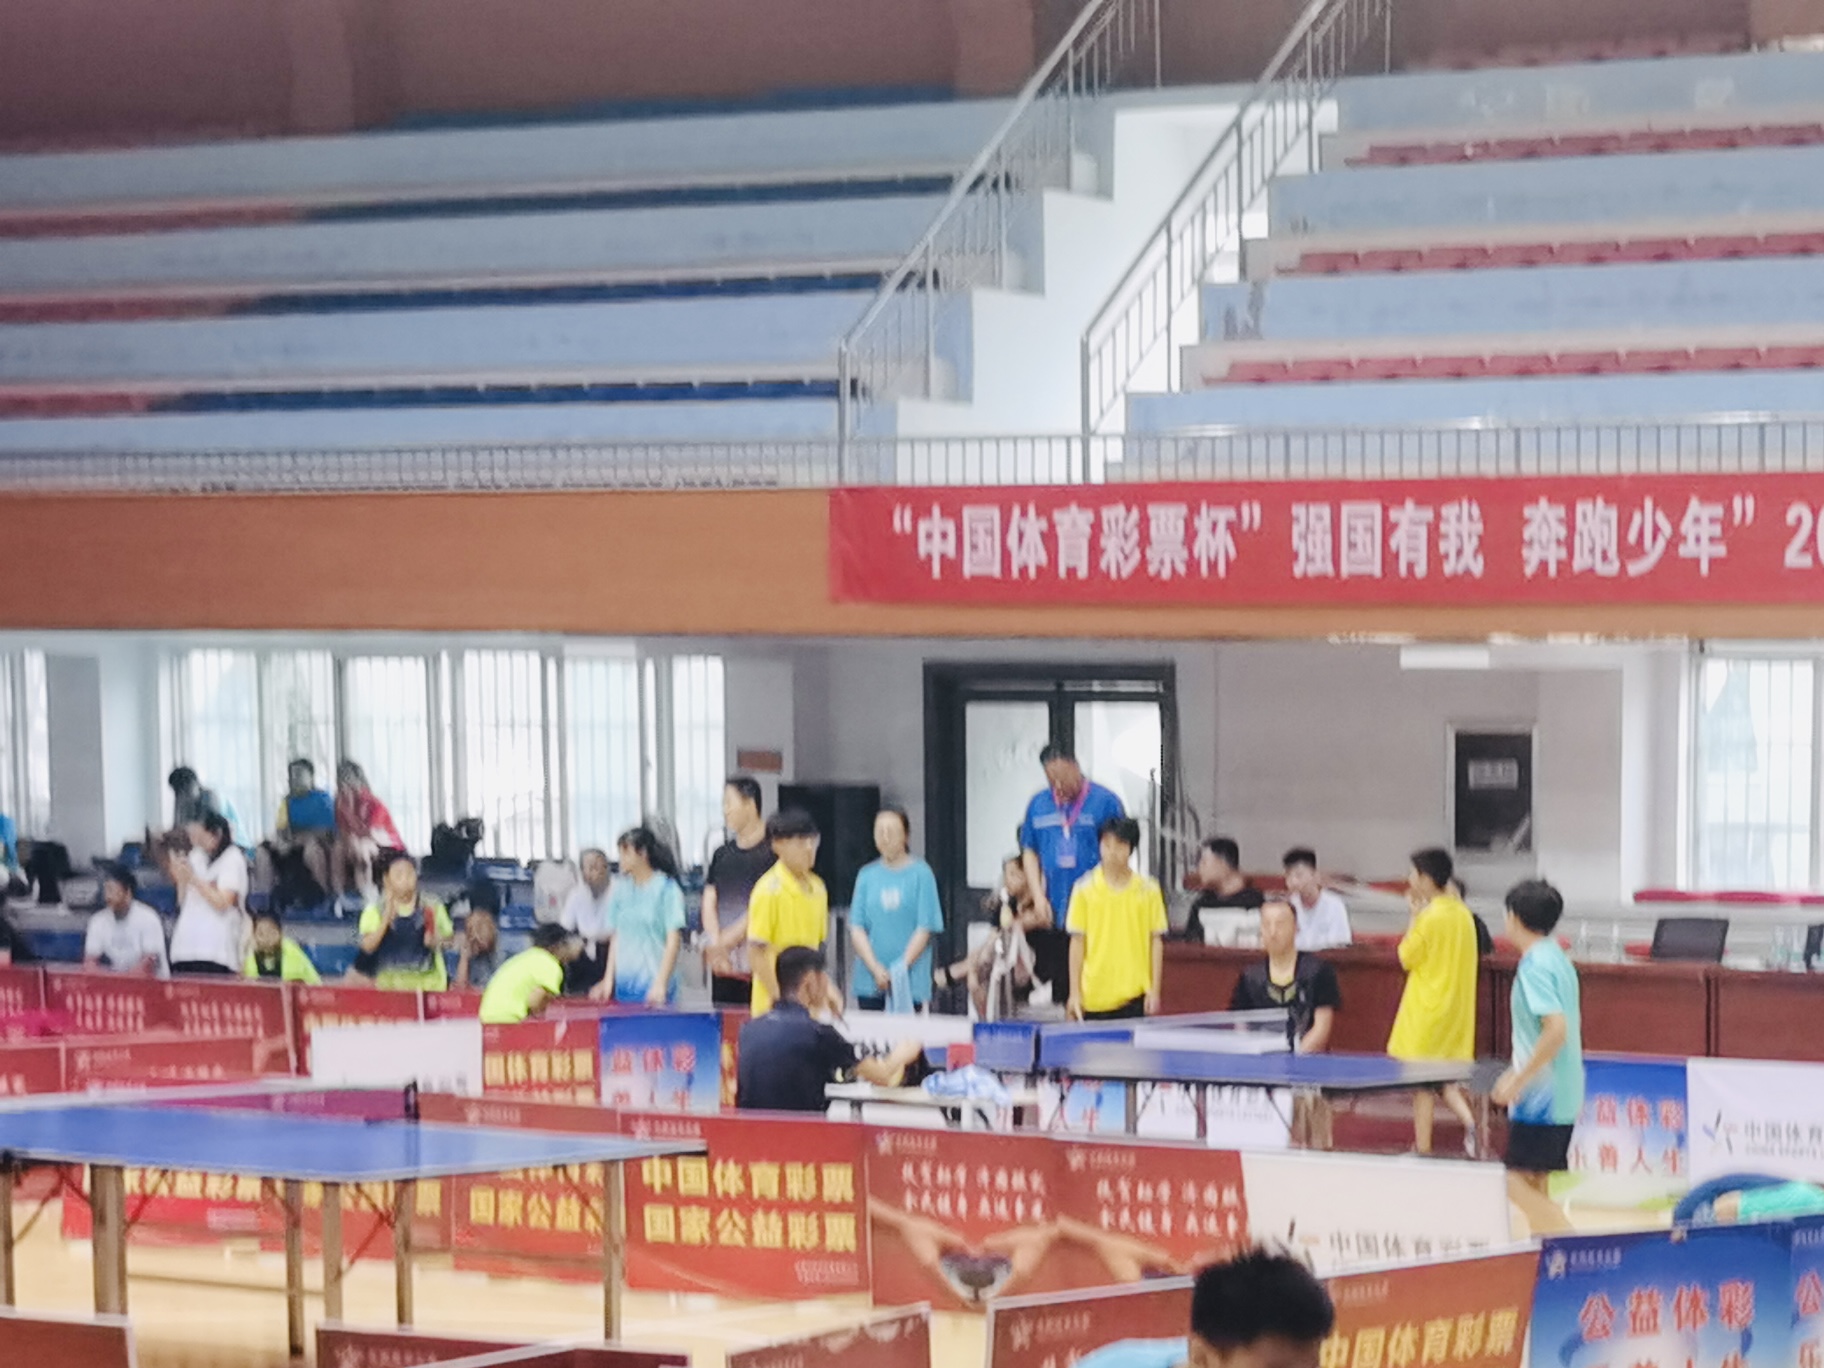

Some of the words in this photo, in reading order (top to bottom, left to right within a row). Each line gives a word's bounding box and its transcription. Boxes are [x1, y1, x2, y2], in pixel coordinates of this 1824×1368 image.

[893, 501, 1262, 580] “中国体育彩票杯”
[1291, 496, 1484, 579] 强国有我
[1521, 493, 1755, 578] 奔跑少年”
[1579, 1278, 1755, 1342] 公益体彩
